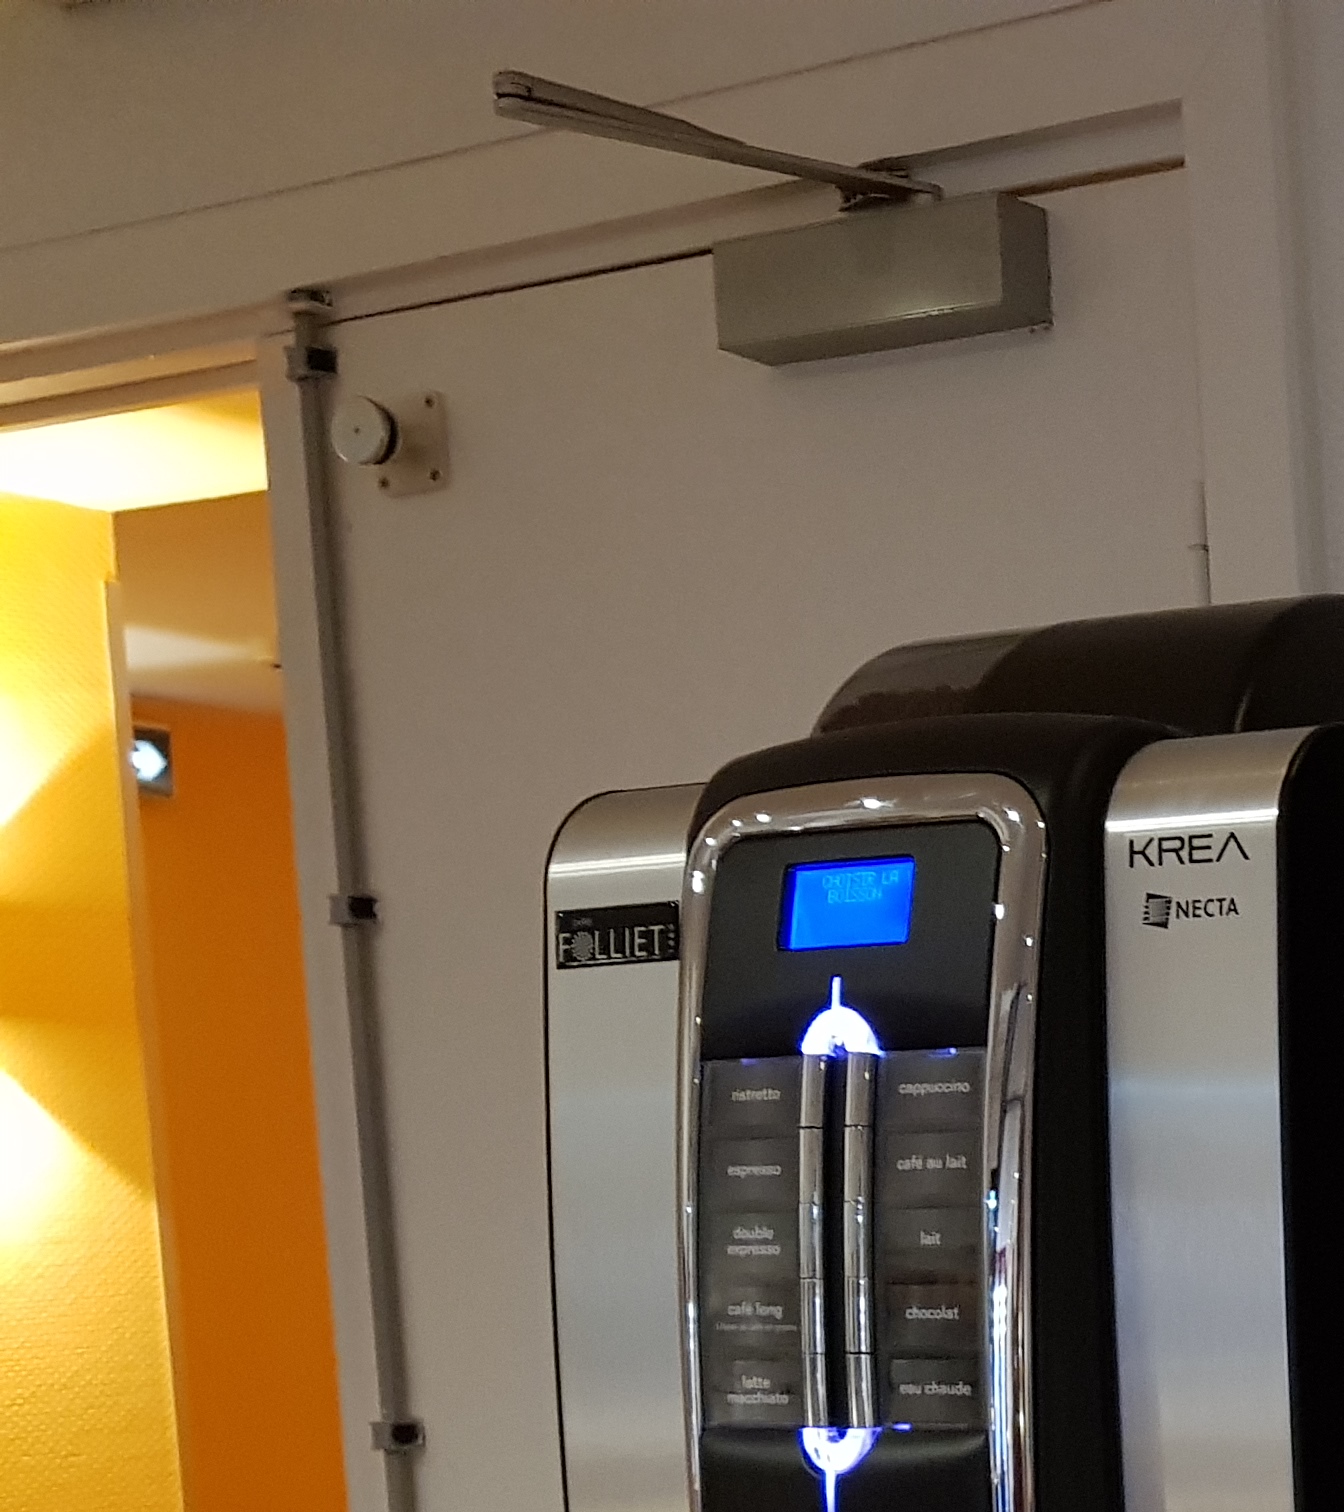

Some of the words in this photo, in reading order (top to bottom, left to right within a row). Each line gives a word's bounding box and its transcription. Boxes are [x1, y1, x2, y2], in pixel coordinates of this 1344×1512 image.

[1175, 897, 1239, 919] NECTA
[731, 1088, 781, 1102] ristretto
[898, 1081, 970, 1096] cappuccino
[926, 1157, 943, 1169] au
[945, 1153, 968, 1169] lait
[727, 1164, 782, 1178] espresso
[733, 1226, 774, 1240] double
[920, 1229, 941, 1247] lait
[755, 1301, 783, 1320] long
[905, 1304, 960, 1320] chocolat
[741, 1374, 771, 1389] latte
[899, 1383, 922, 1395] eau
[923, 1381, 972, 1396] chaude
